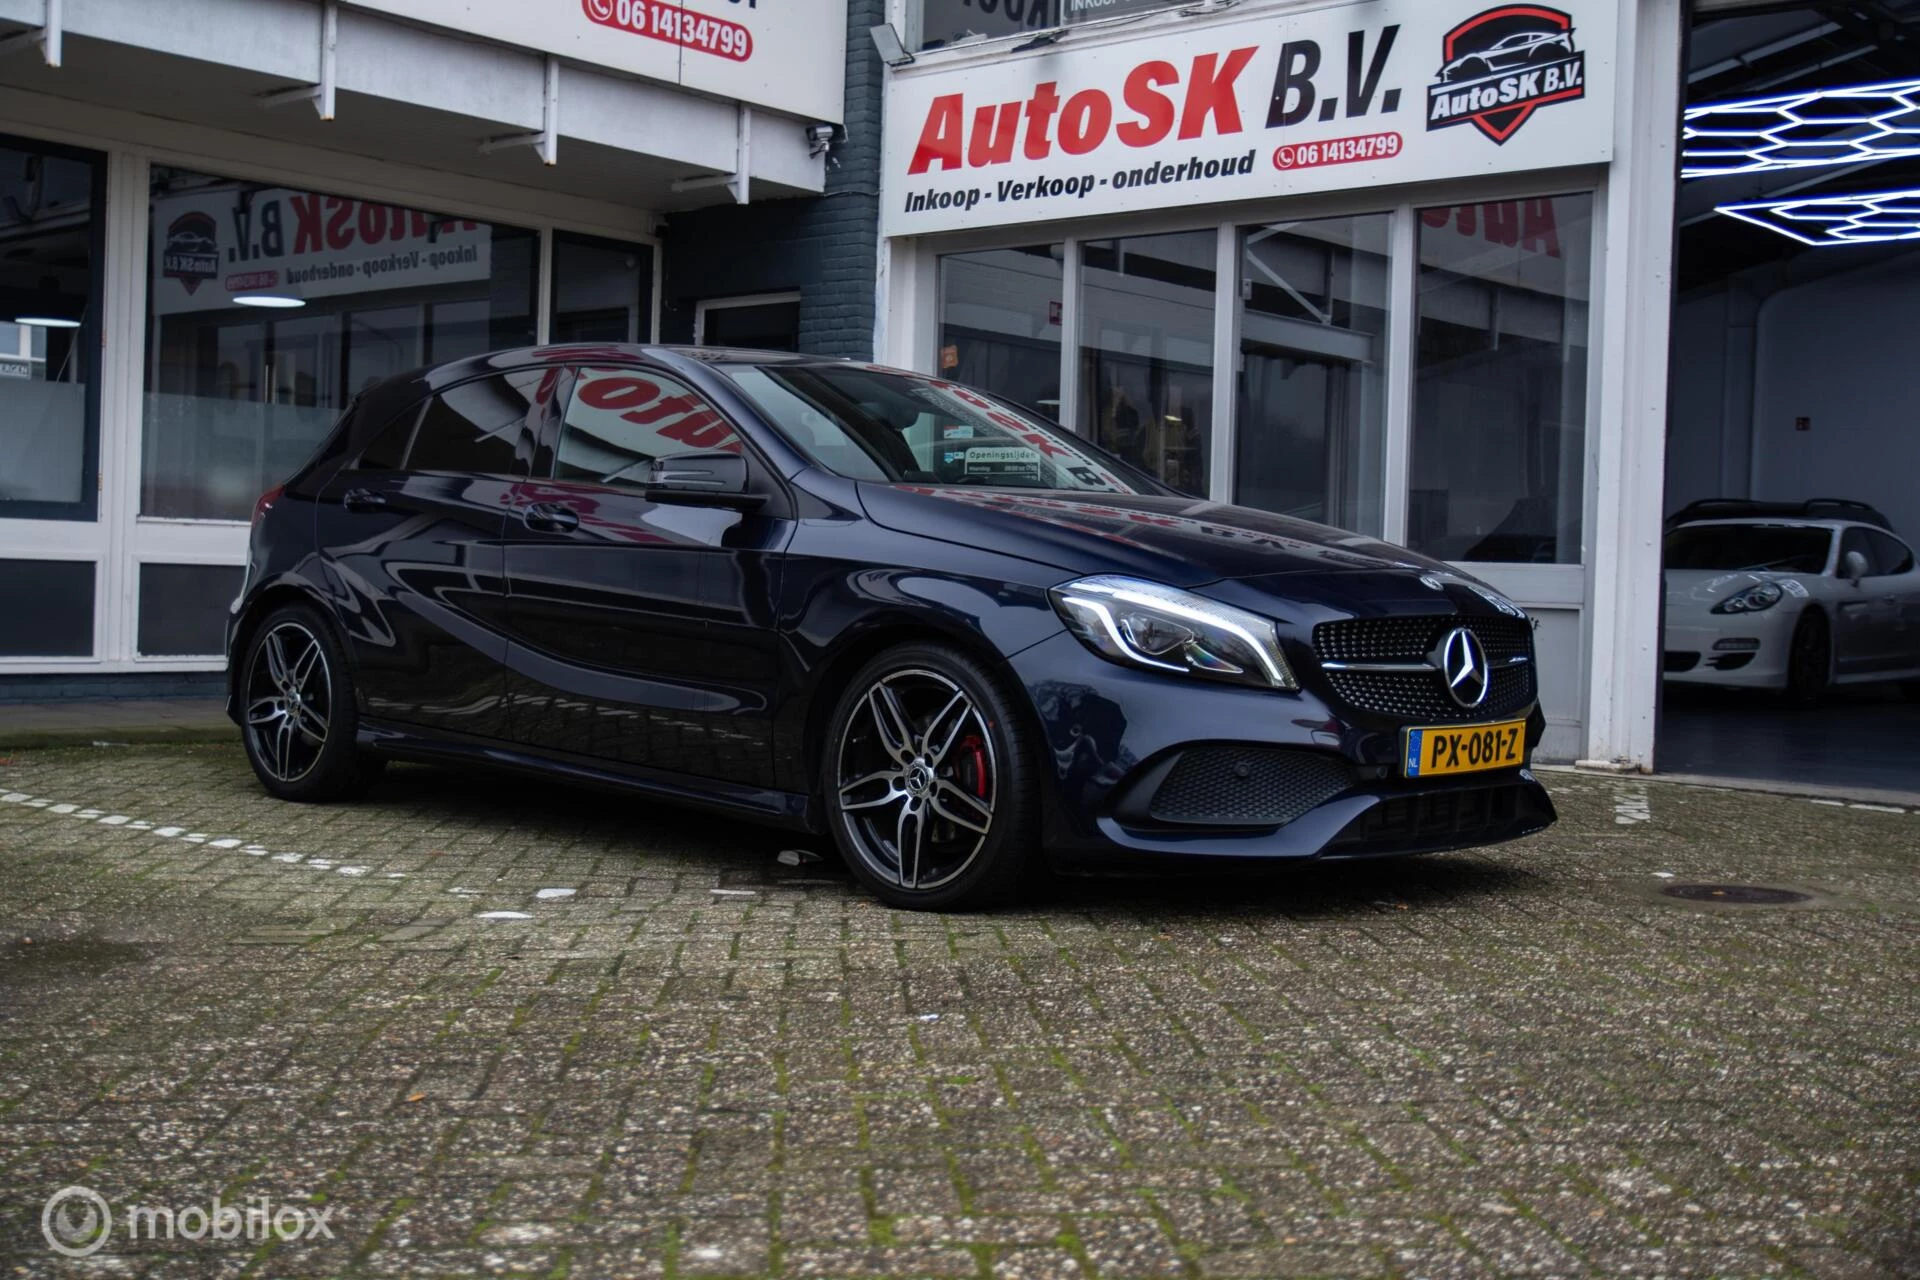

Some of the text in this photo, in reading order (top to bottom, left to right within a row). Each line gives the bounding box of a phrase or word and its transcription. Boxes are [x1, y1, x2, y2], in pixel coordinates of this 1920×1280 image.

[616, 0, 748, 57] 06 14134799
[907, 24, 1402, 175] AutoSK B.V.
[1430, 61, 1584, 121] AutoSK B.V.
[1296, 134, 1399, 165] 06 14134799
[904, 187, 980, 213] Inkoop
[997, 173, 1095, 202] Verkoop
[1112, 149, 1257, 190] onderhoud
[1408, 758, 1418, 767] NL
[1431, 728, 1519, 768] PX-081-Z
